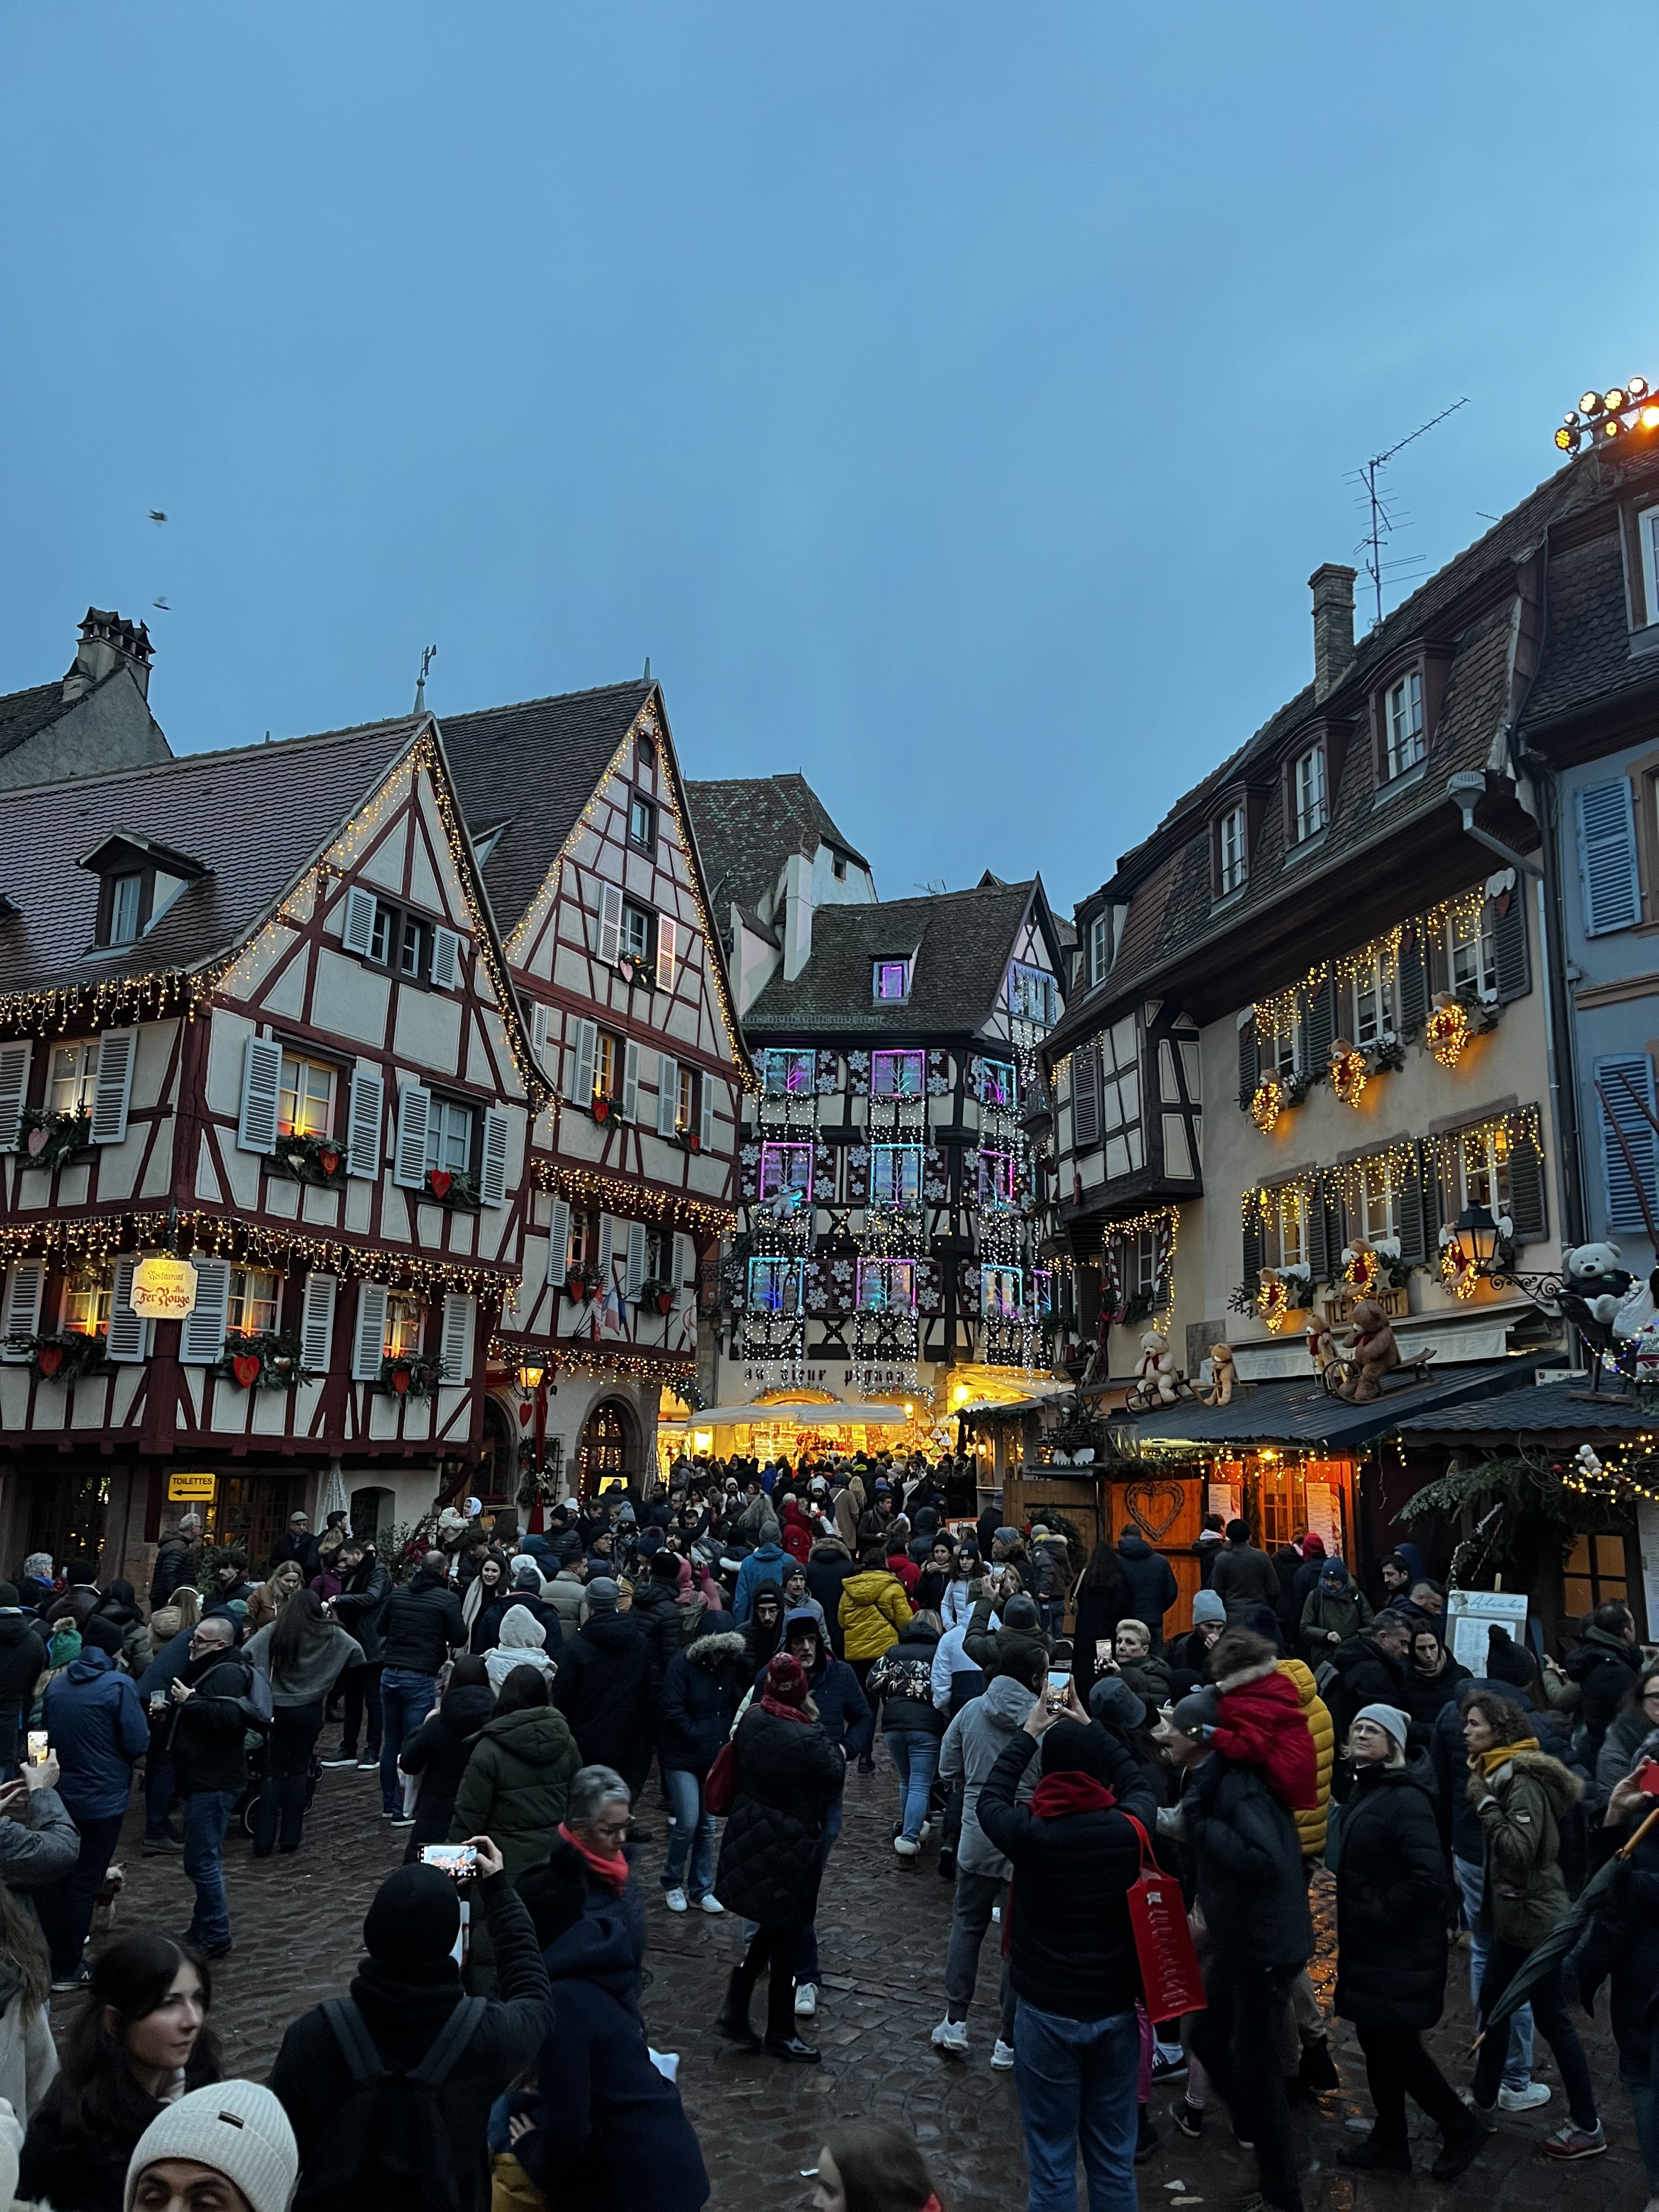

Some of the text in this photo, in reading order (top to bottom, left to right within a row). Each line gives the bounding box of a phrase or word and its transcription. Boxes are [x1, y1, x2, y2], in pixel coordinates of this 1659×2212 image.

[148, 1270, 184, 1281] Restaurant
[133, 1286, 190, 1308] Fer Rouge
[1333, 1301, 1347, 1323] LE
